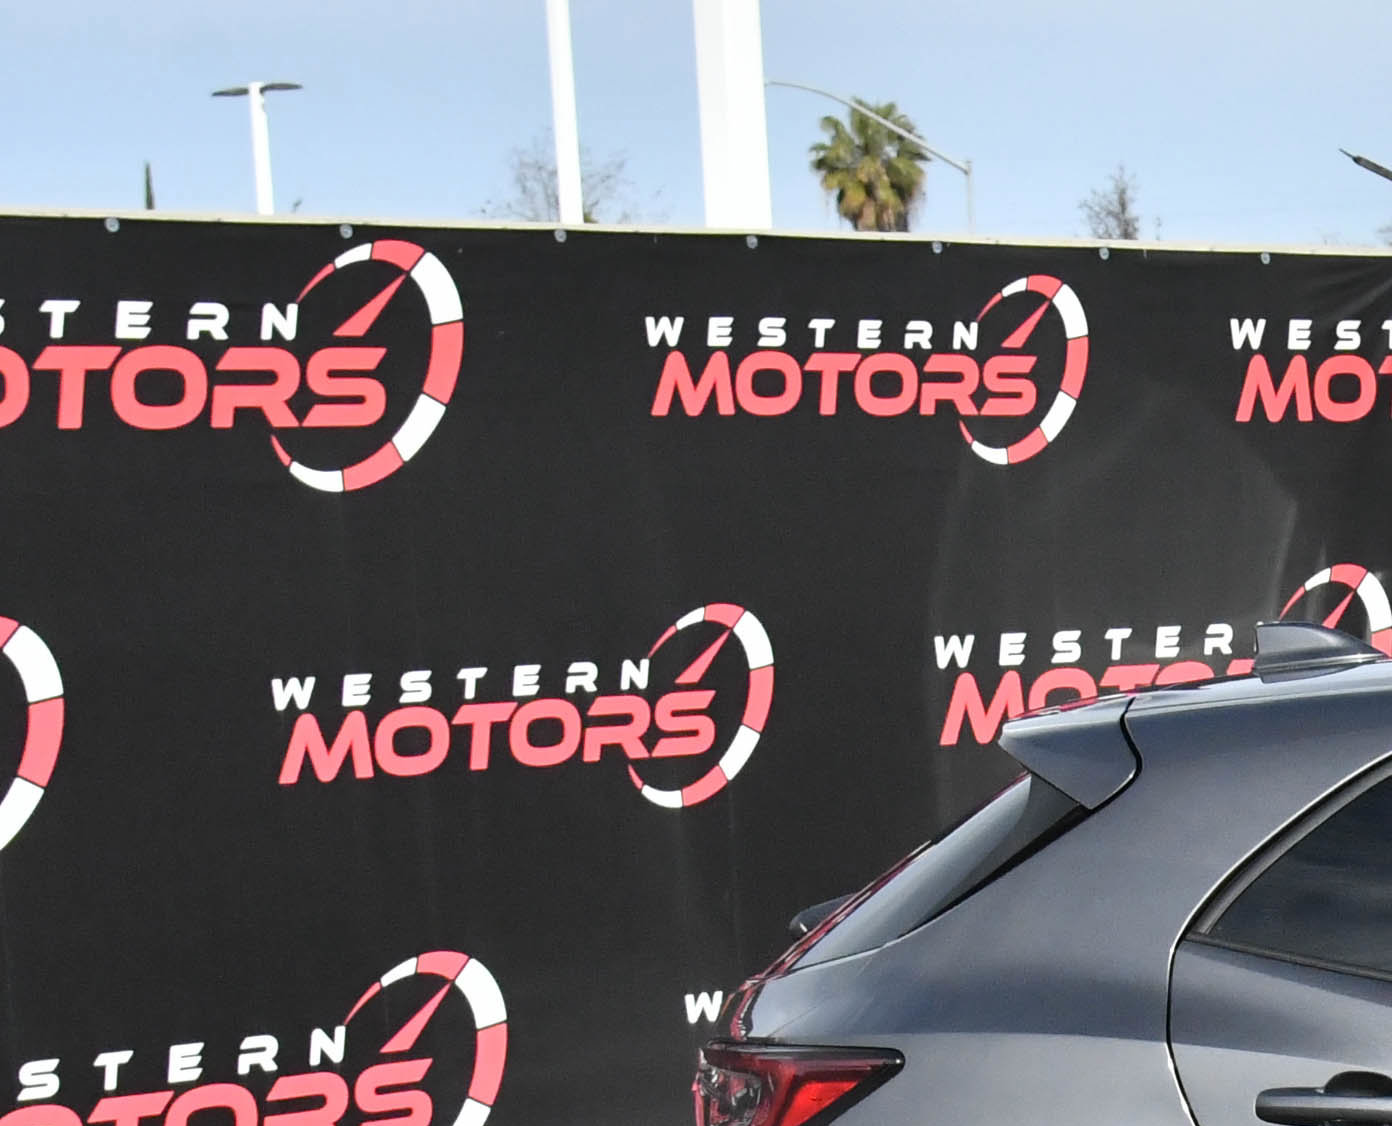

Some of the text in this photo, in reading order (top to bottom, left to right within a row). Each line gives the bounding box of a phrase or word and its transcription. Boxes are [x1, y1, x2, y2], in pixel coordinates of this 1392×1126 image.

[0, 298, 299, 341] TERN
[645, 316, 979, 351] WESTERN
[651, 350, 1038, 417] MOTORS
[933, 622, 1260, 670] WESTER
[271, 658, 650, 711] WESTERN
[278, 689, 716, 785] MOTORS
[17, 1025, 346, 1102] STERN
